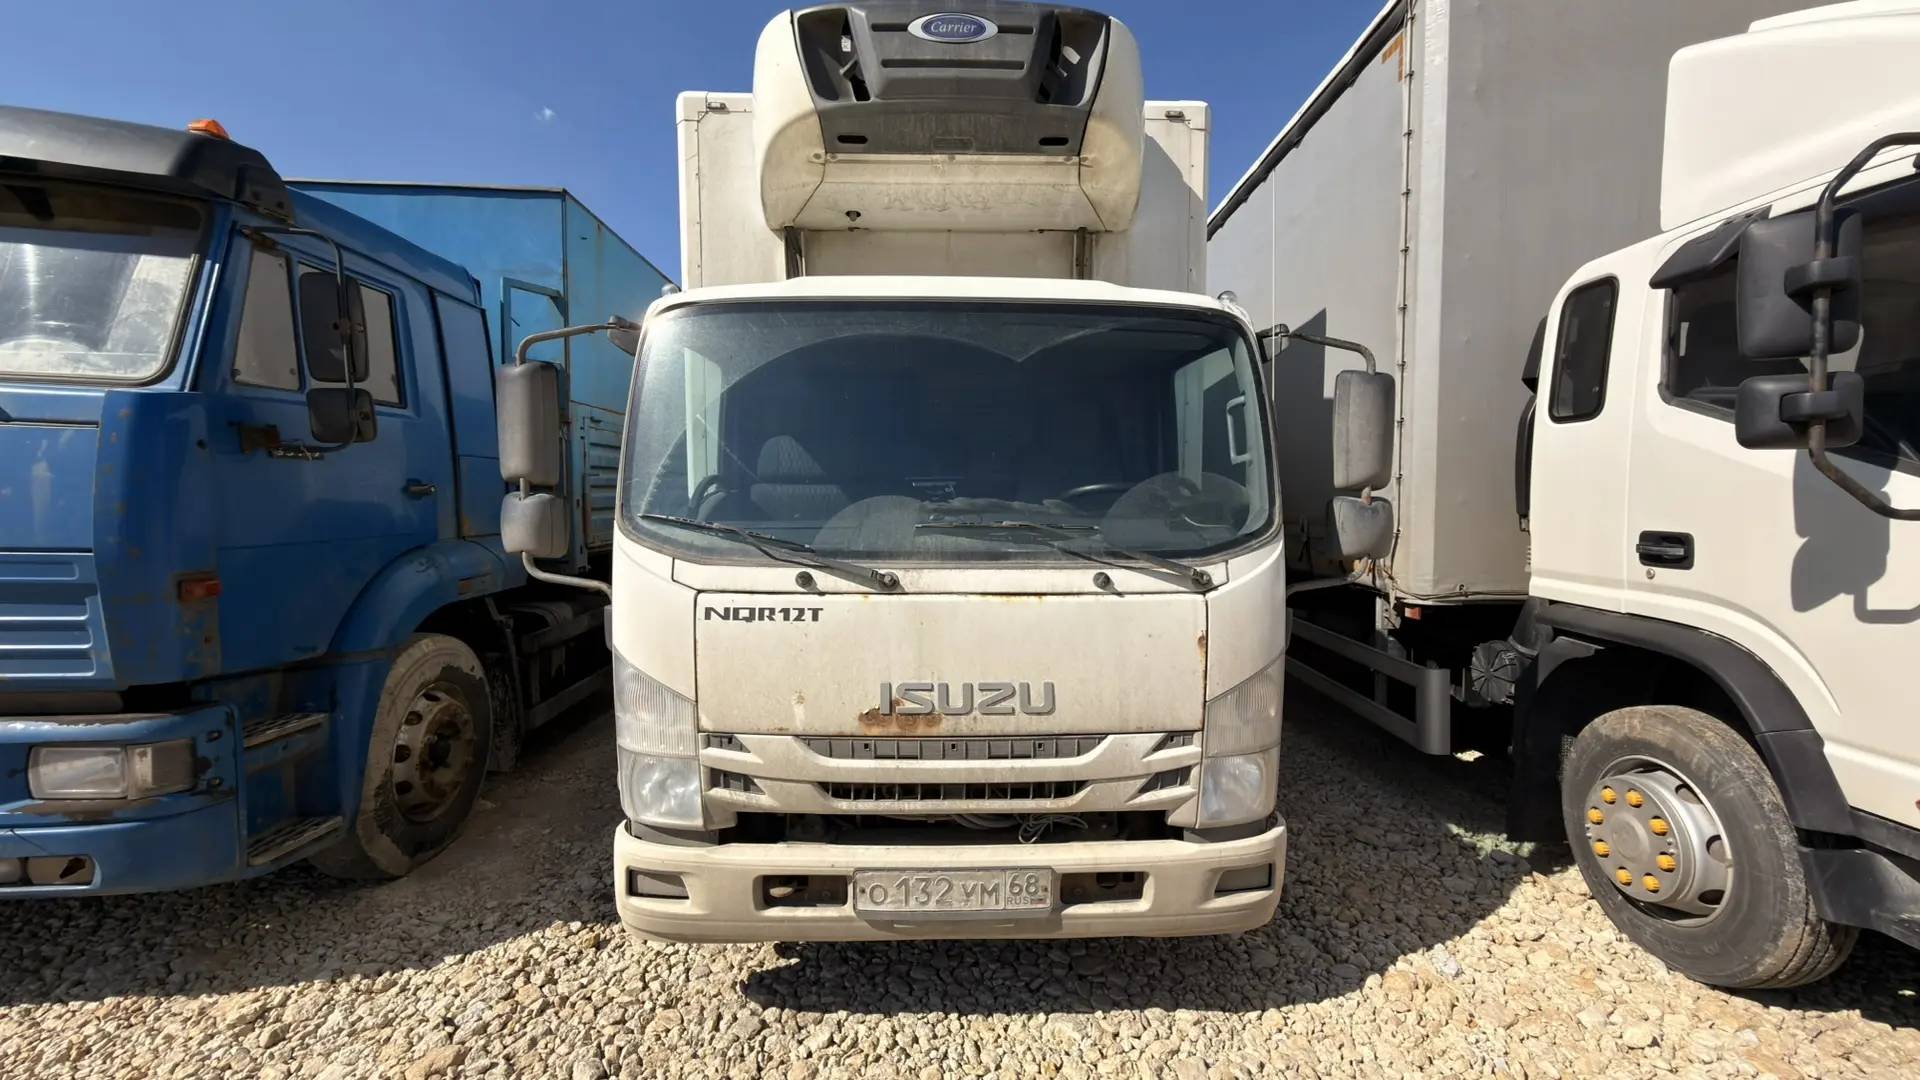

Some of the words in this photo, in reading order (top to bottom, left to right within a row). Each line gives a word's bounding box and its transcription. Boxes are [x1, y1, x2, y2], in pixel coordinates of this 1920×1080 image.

[931, 21, 977, 33] Carrier
[704, 606, 824, 623] NQR12T
[879, 681, 1056, 716] ISUZU
[1006, 896, 1029, 905] RUS
